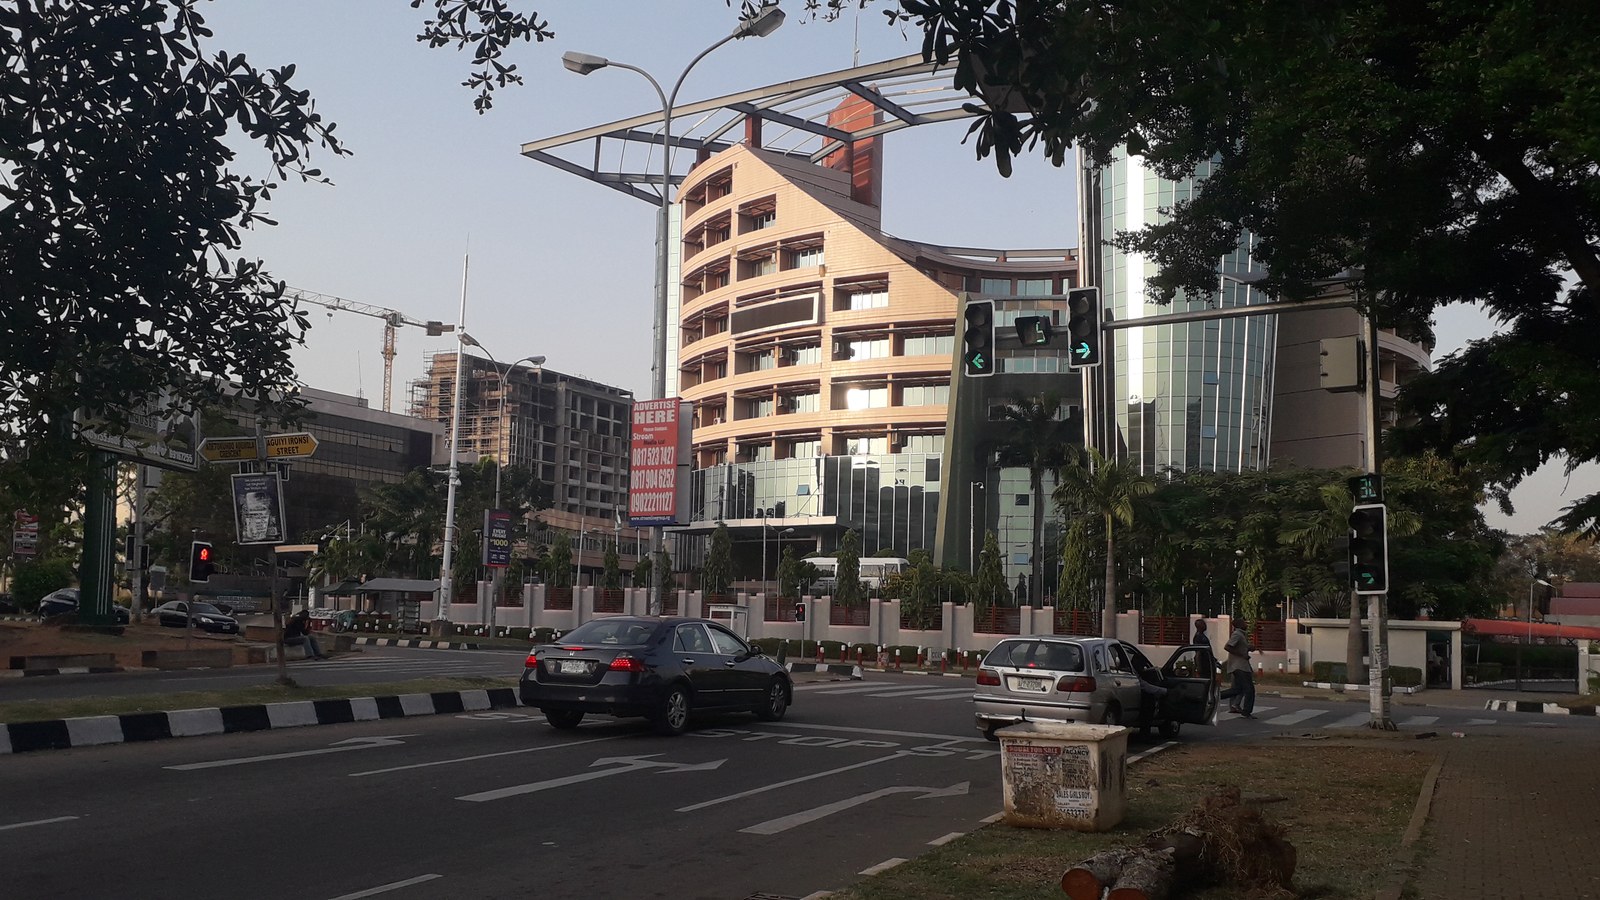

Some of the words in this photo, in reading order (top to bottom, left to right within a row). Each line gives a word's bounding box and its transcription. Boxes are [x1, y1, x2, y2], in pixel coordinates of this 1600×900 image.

[1035, 321, 1046, 343] 5
[633, 401, 676, 411] ADVERTISE
[633, 409, 676, 425] HERE
[266, 439, 288, 447] AGUIYI
[288, 436, 310, 445] IRONSI
[276, 446, 300, 456] STREET
[633, 448, 647, 466] 0817
[647, 447, 659, 466] 523
[660, 446, 674, 465] 7427
[631, 470, 645, 489] 0817
[645, 469, 658, 489] 904
[658, 468, 675, 488] 6252
[684, 729, 901, 748] STOP
